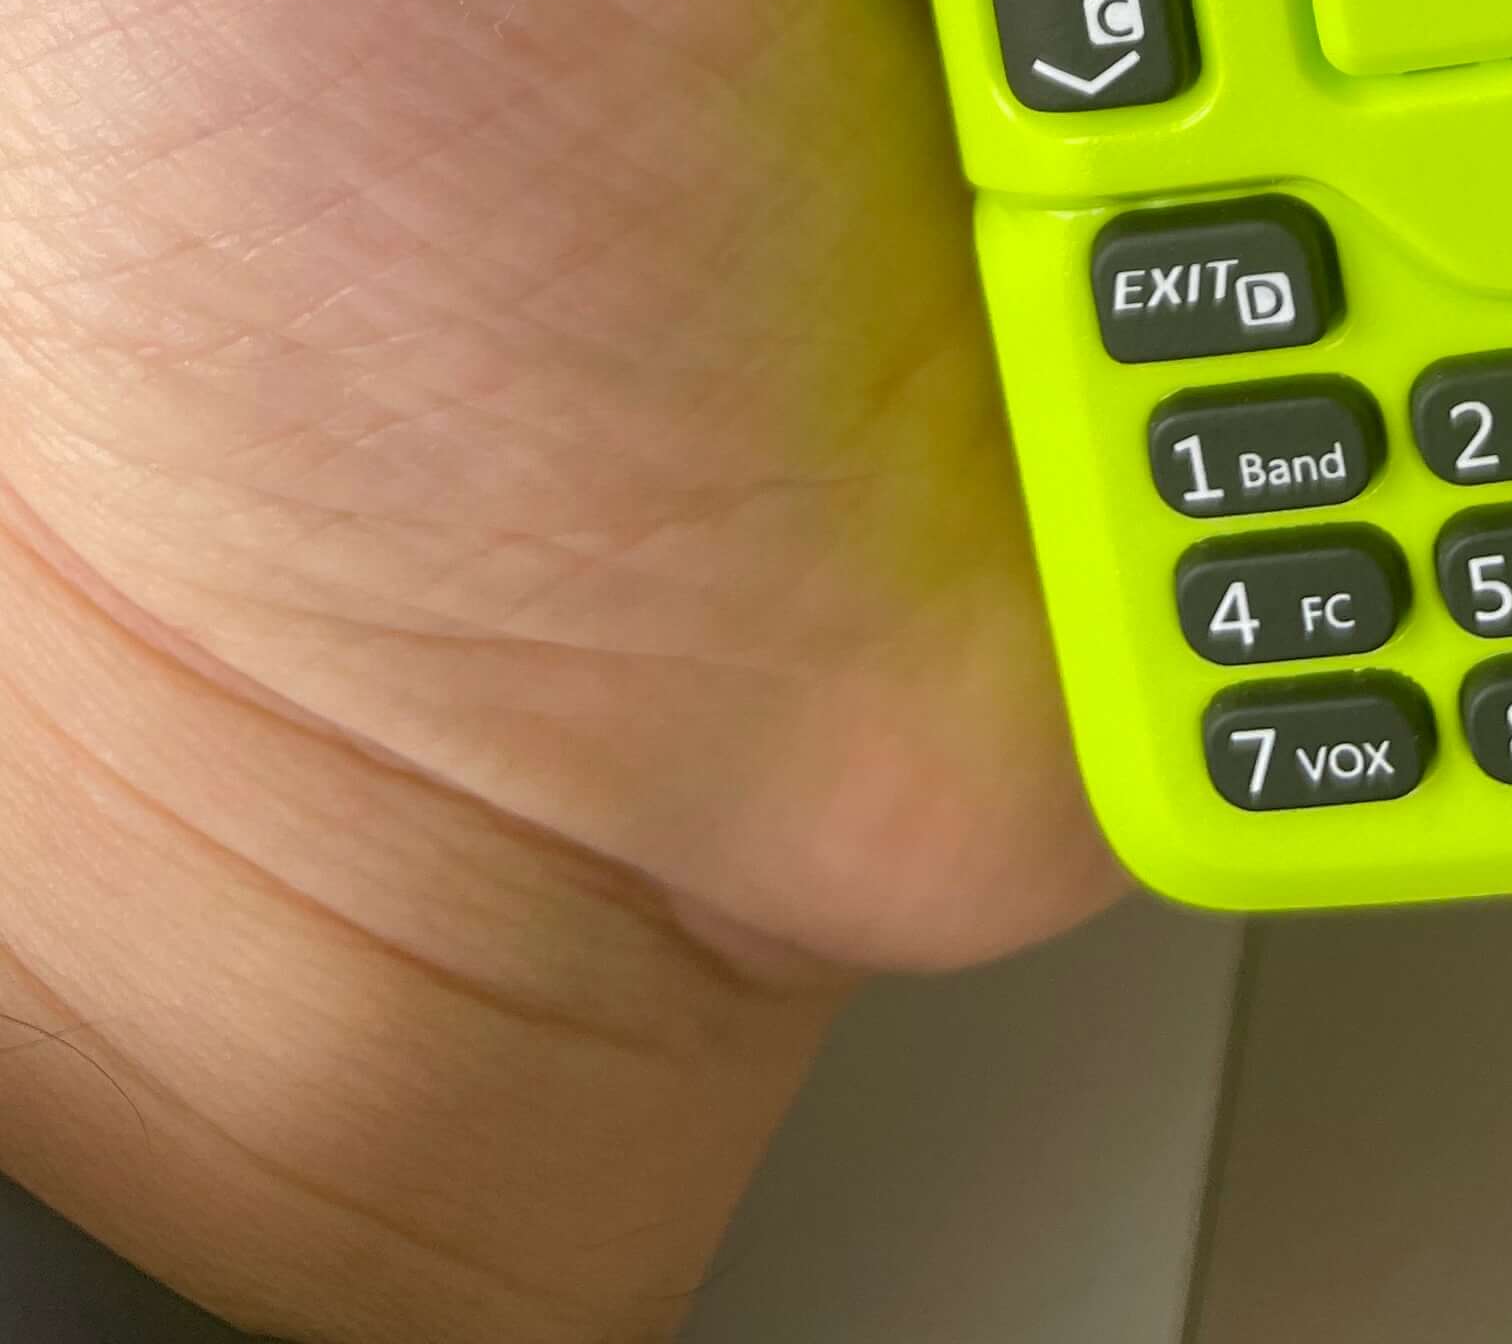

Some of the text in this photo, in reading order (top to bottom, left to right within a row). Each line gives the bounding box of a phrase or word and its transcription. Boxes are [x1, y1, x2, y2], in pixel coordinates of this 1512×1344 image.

[1113, 259, 1283, 321] EXIT D
[1173, 435, 1346, 503] 1 Band
[1450, 401, 1500, 471] 2
[1209, 581, 1355, 647] 4 FC
[1230, 728, 1395, 795] 7 VOX
